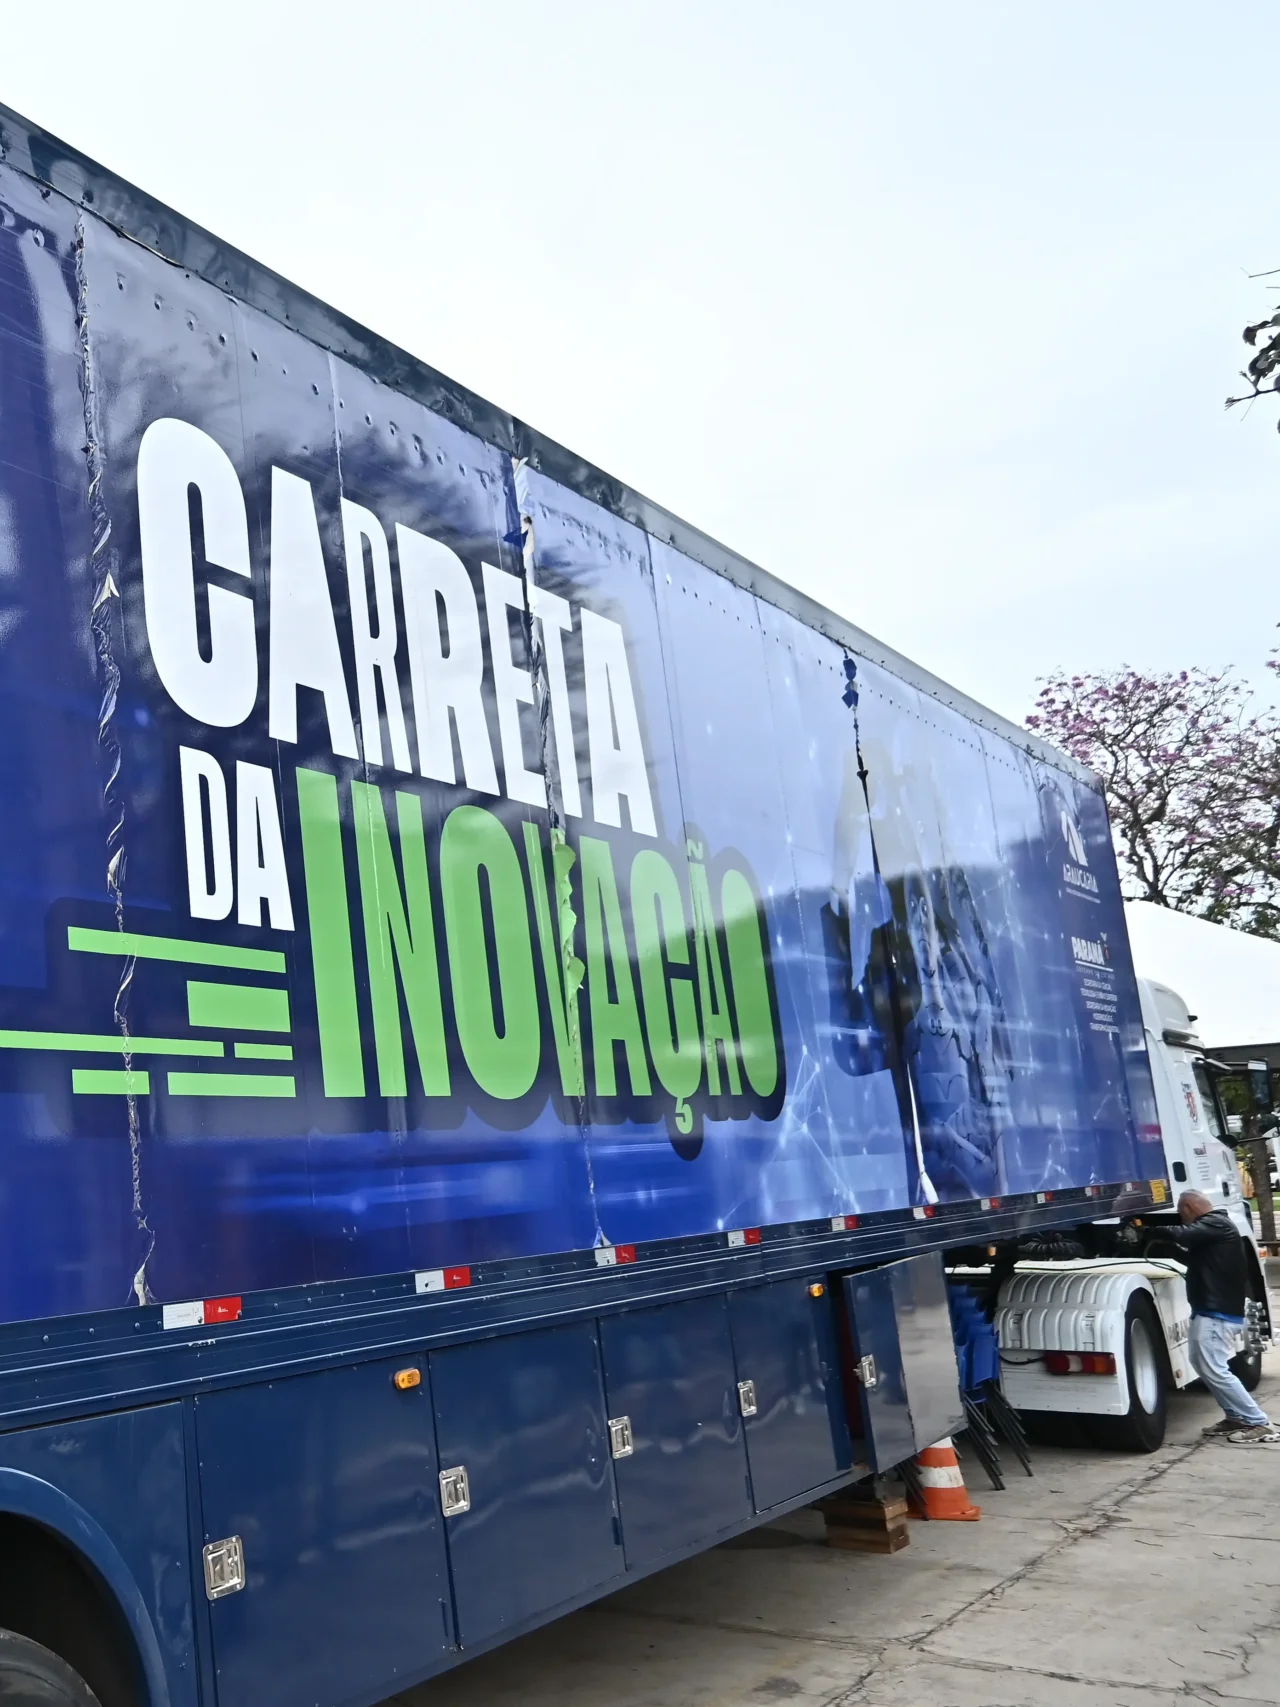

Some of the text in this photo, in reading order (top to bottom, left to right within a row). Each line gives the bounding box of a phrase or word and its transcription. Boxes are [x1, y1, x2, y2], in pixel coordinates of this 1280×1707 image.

[136, 416, 659, 838] CARRETA
[179, 745, 779, 1135] DA INOVAÇÃO
[1071, 936, 1105, 966] PARANÁ
